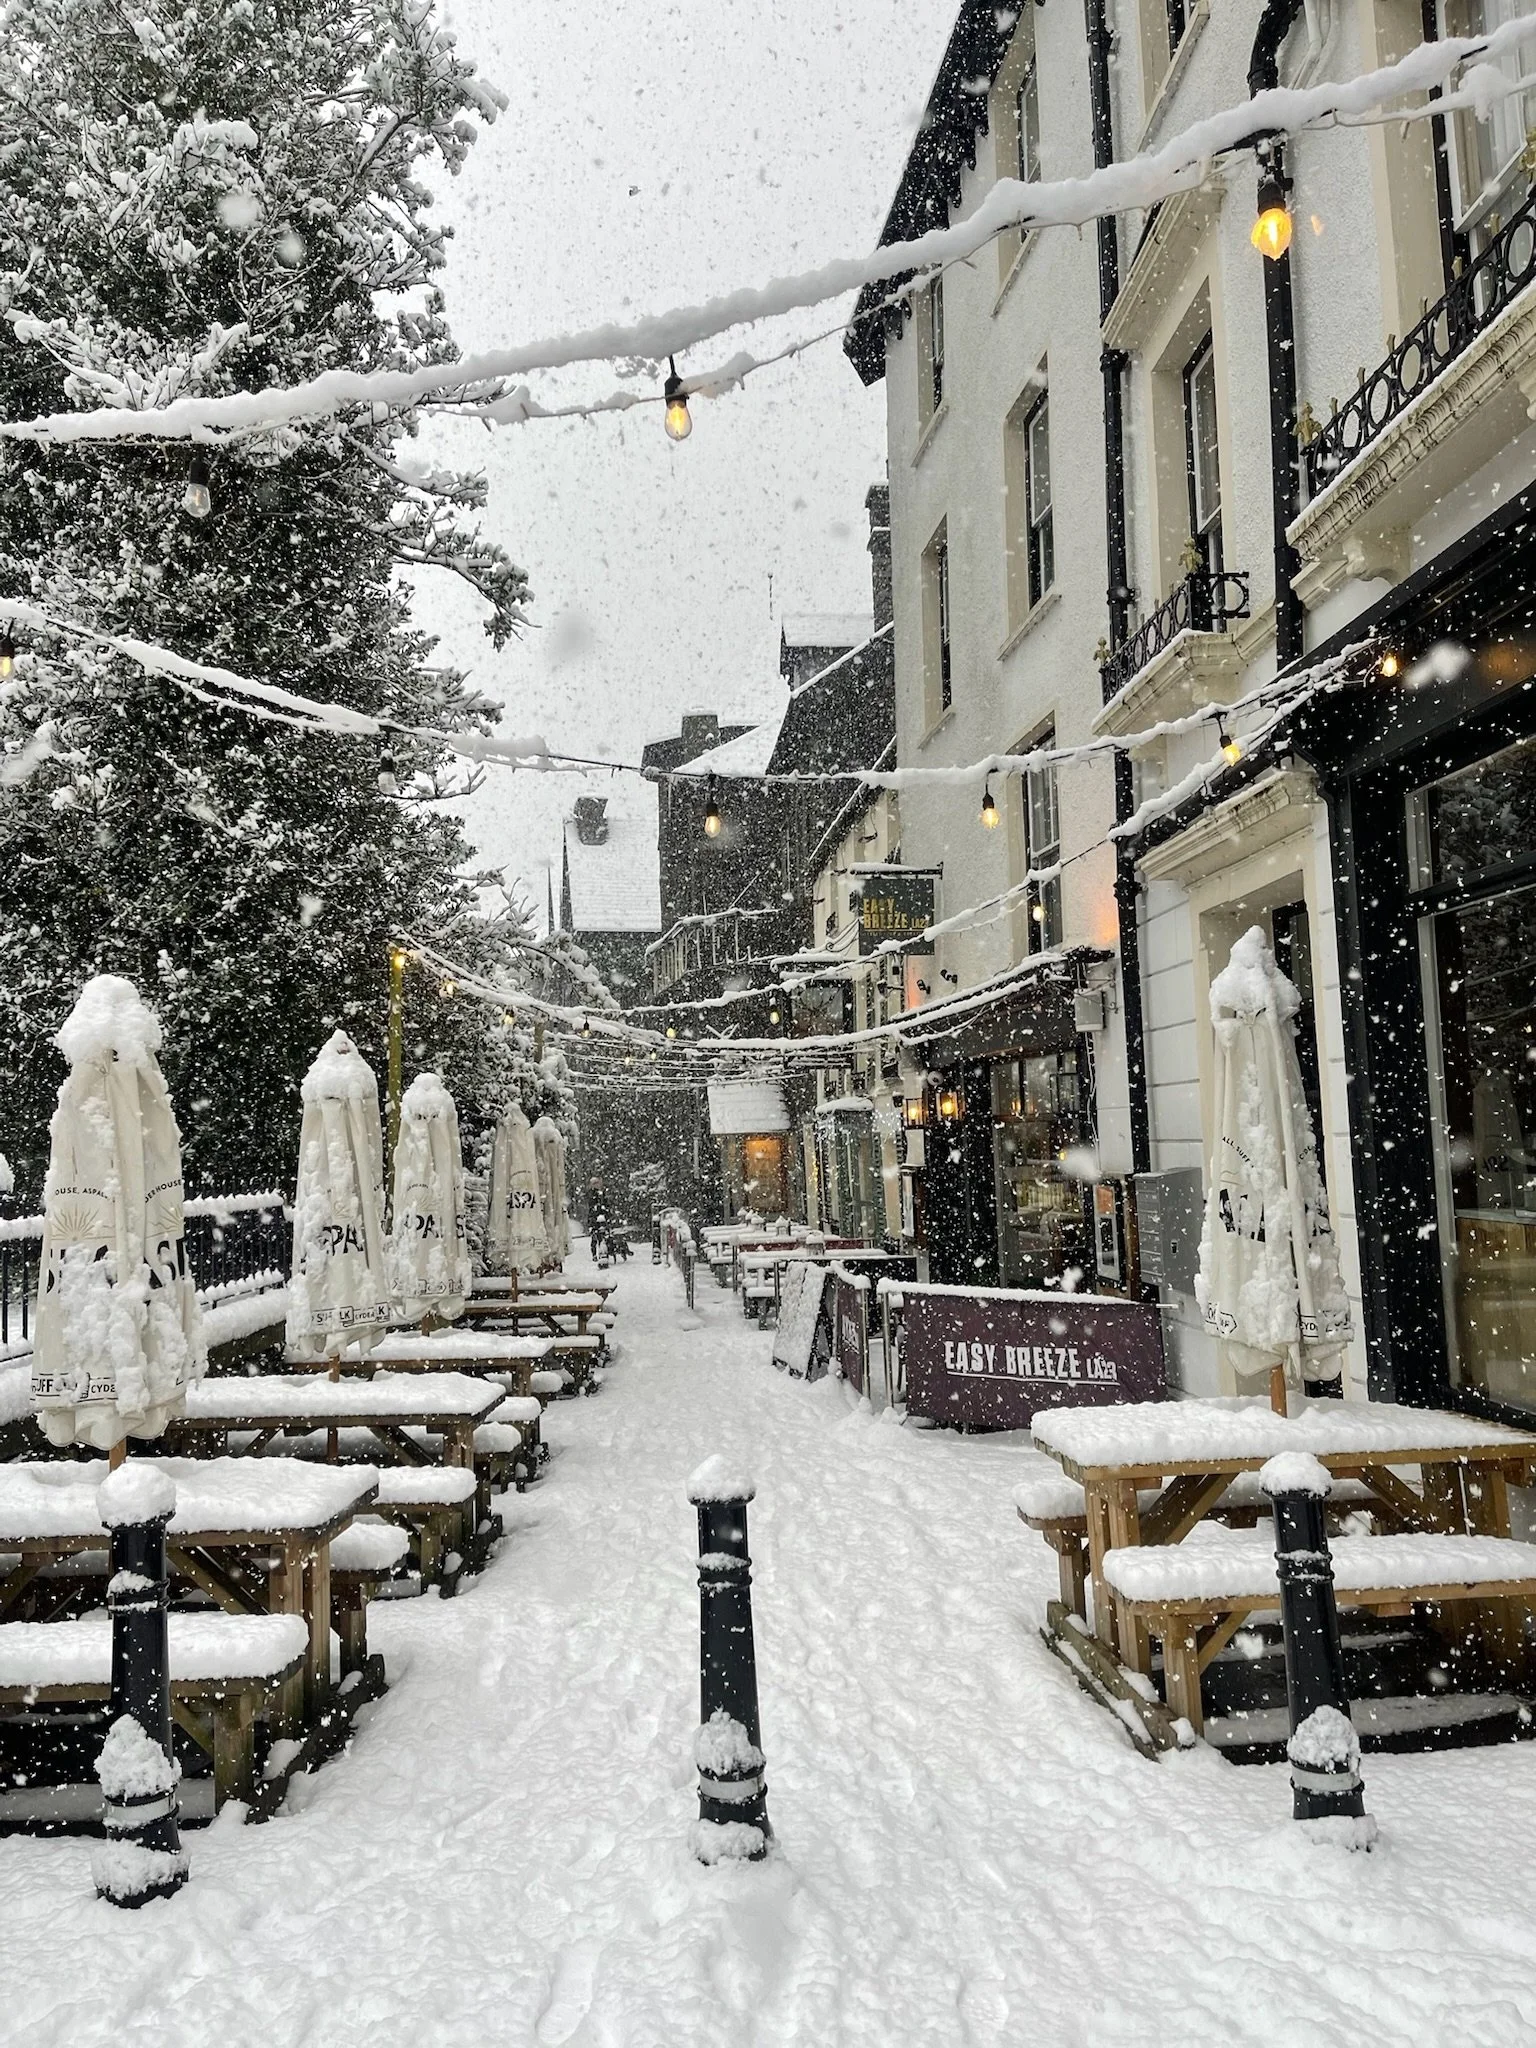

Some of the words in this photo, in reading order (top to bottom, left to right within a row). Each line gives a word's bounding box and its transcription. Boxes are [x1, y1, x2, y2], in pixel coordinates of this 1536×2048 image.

[944, 1340, 996, 1373] EASY
[1005, 1345, 1081, 1378] BREEZE
[1086, 1357, 1118, 1380] LA23
